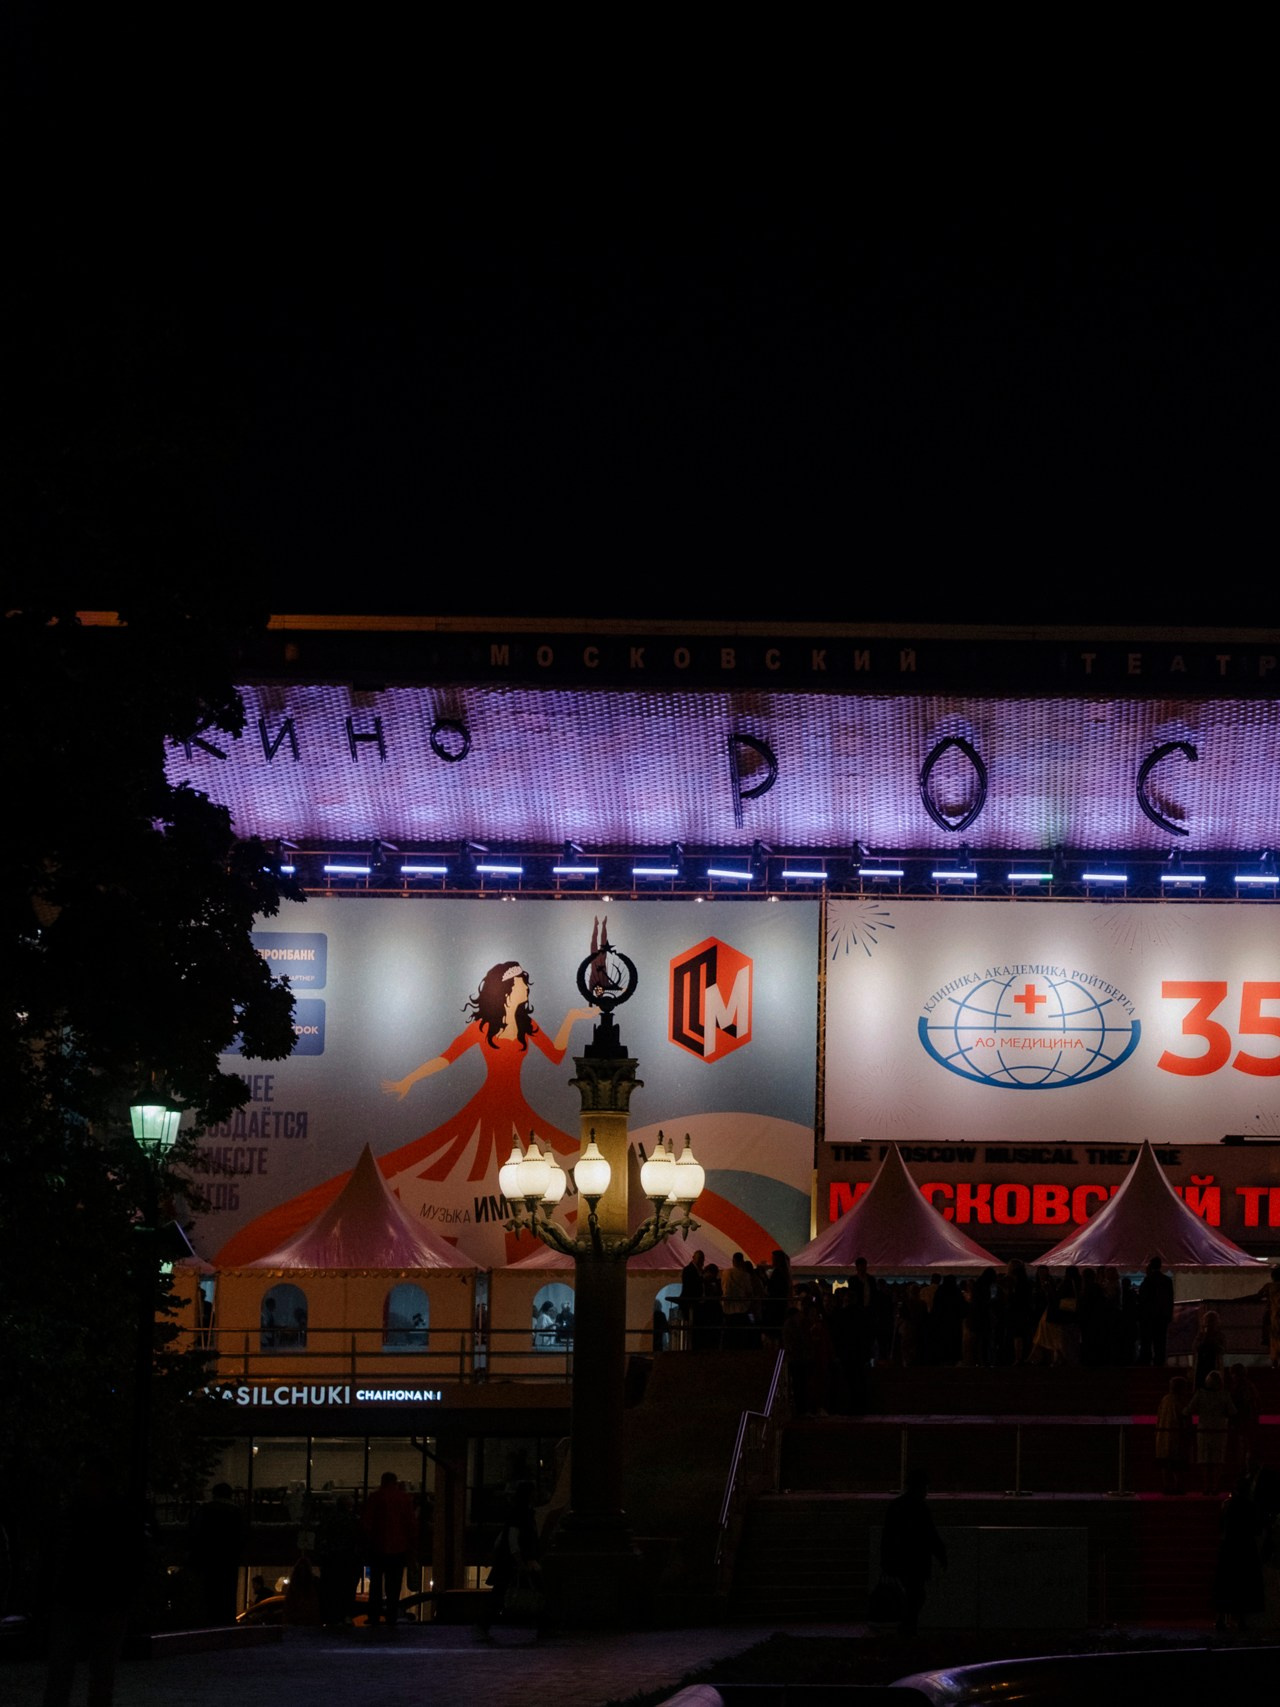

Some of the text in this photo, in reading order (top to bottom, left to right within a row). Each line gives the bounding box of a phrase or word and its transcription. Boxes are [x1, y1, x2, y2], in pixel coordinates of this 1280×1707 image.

[490, 642, 919, 675] МОСКОВСКИЙ
[1081, 652, 1278, 678] ТЕАТР
[923, 964, 1137, 1017] КЛИНИКА АКАДЕМИКА РОЙТБЕРГА
[975, 1036, 1085, 1051] АО МЕДИЦИНА
[831, 1146, 872, 1162] THE
[985, 1148, 1079, 1165] MUSICAL
[420, 1203, 472, 1224] МУЗЫКА
[356, 1390, 422, 1401] CHAIHONA
